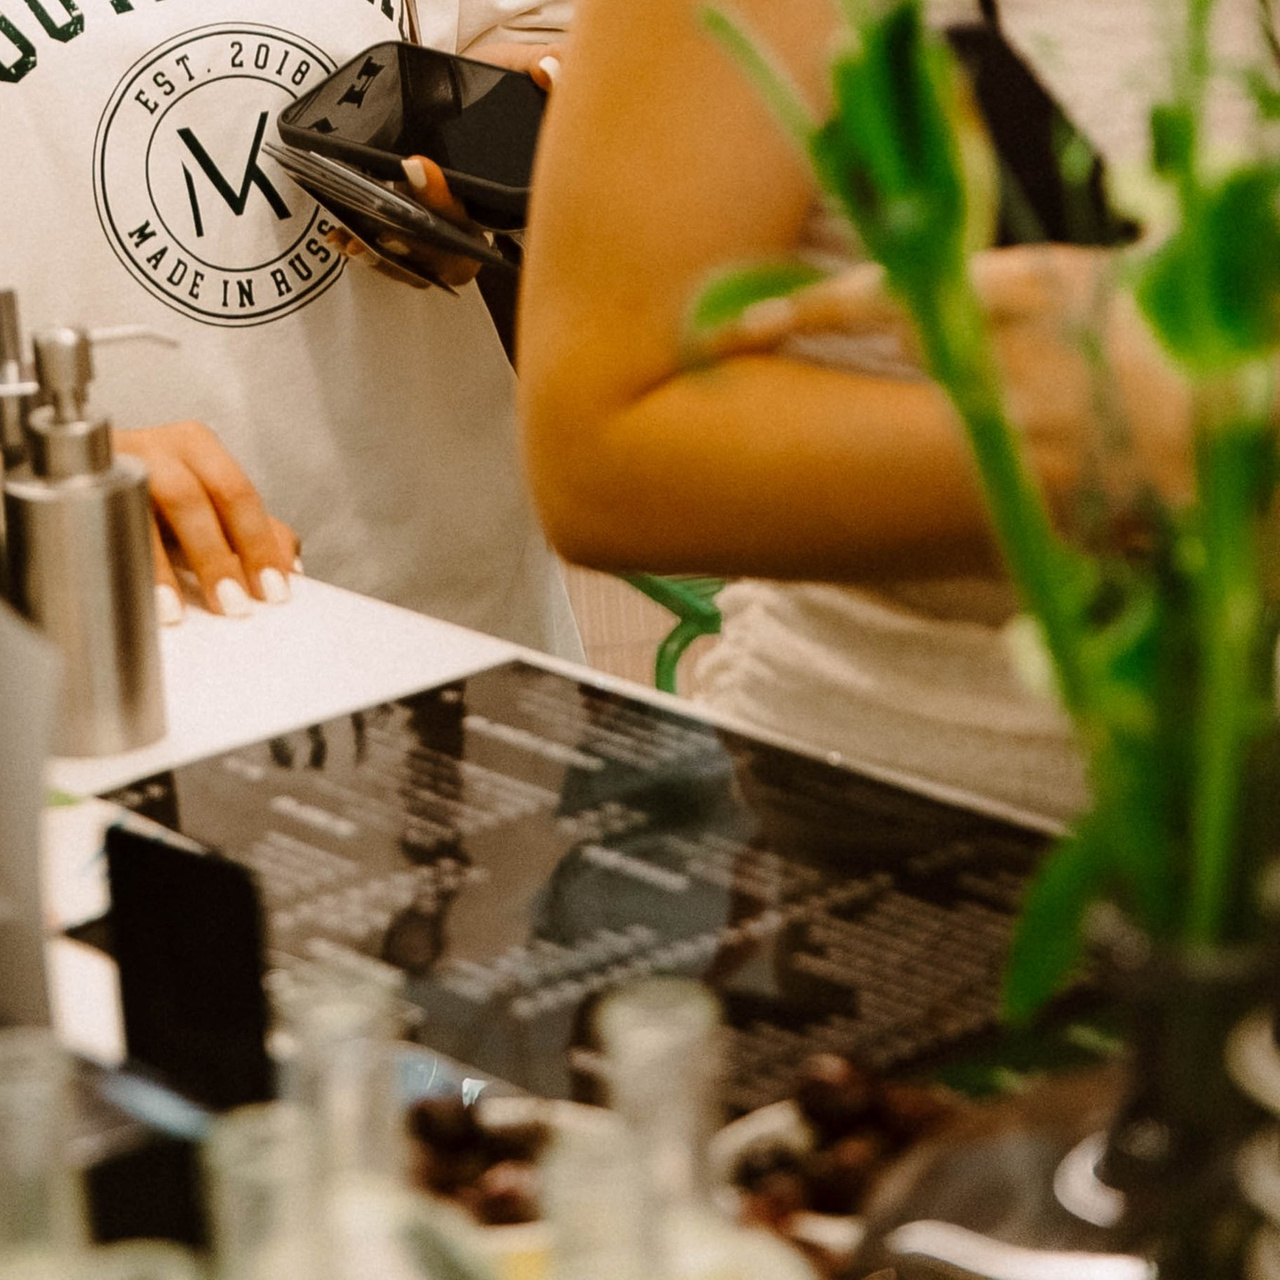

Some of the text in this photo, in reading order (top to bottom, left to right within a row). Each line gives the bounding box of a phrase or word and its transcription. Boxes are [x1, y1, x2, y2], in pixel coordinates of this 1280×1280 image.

[134, 41, 311, 115] EST. 2018
[127, 218, 337, 308] MADE IN RUSS
